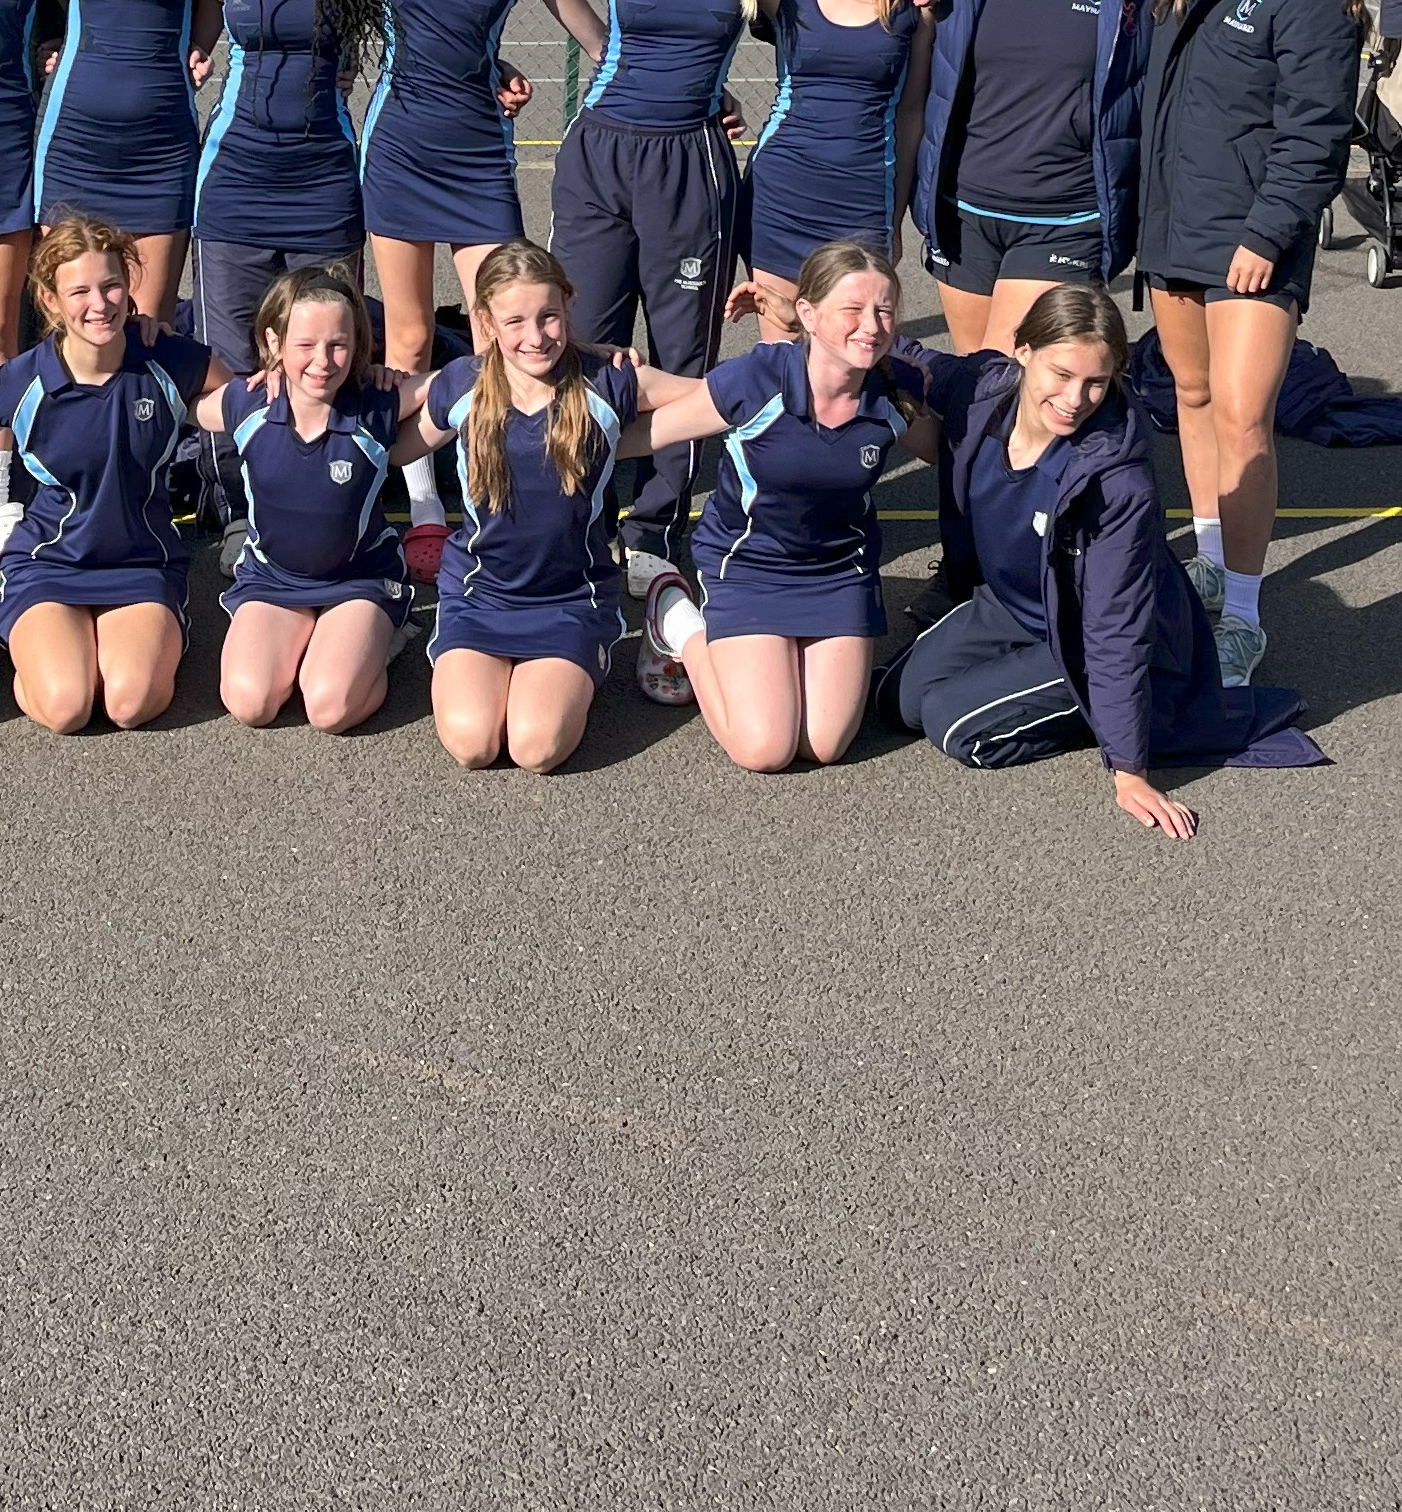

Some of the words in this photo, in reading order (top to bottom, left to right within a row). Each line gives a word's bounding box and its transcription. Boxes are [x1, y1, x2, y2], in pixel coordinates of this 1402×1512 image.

[1071, 3, 1102, 15] MAYNA
[1240, 0, 1257, 16] M
[683, 262, 697, 274] M
[138, 404, 150, 416] M
[865, 450, 876, 463] M
[334, 465, 348, 478] M
